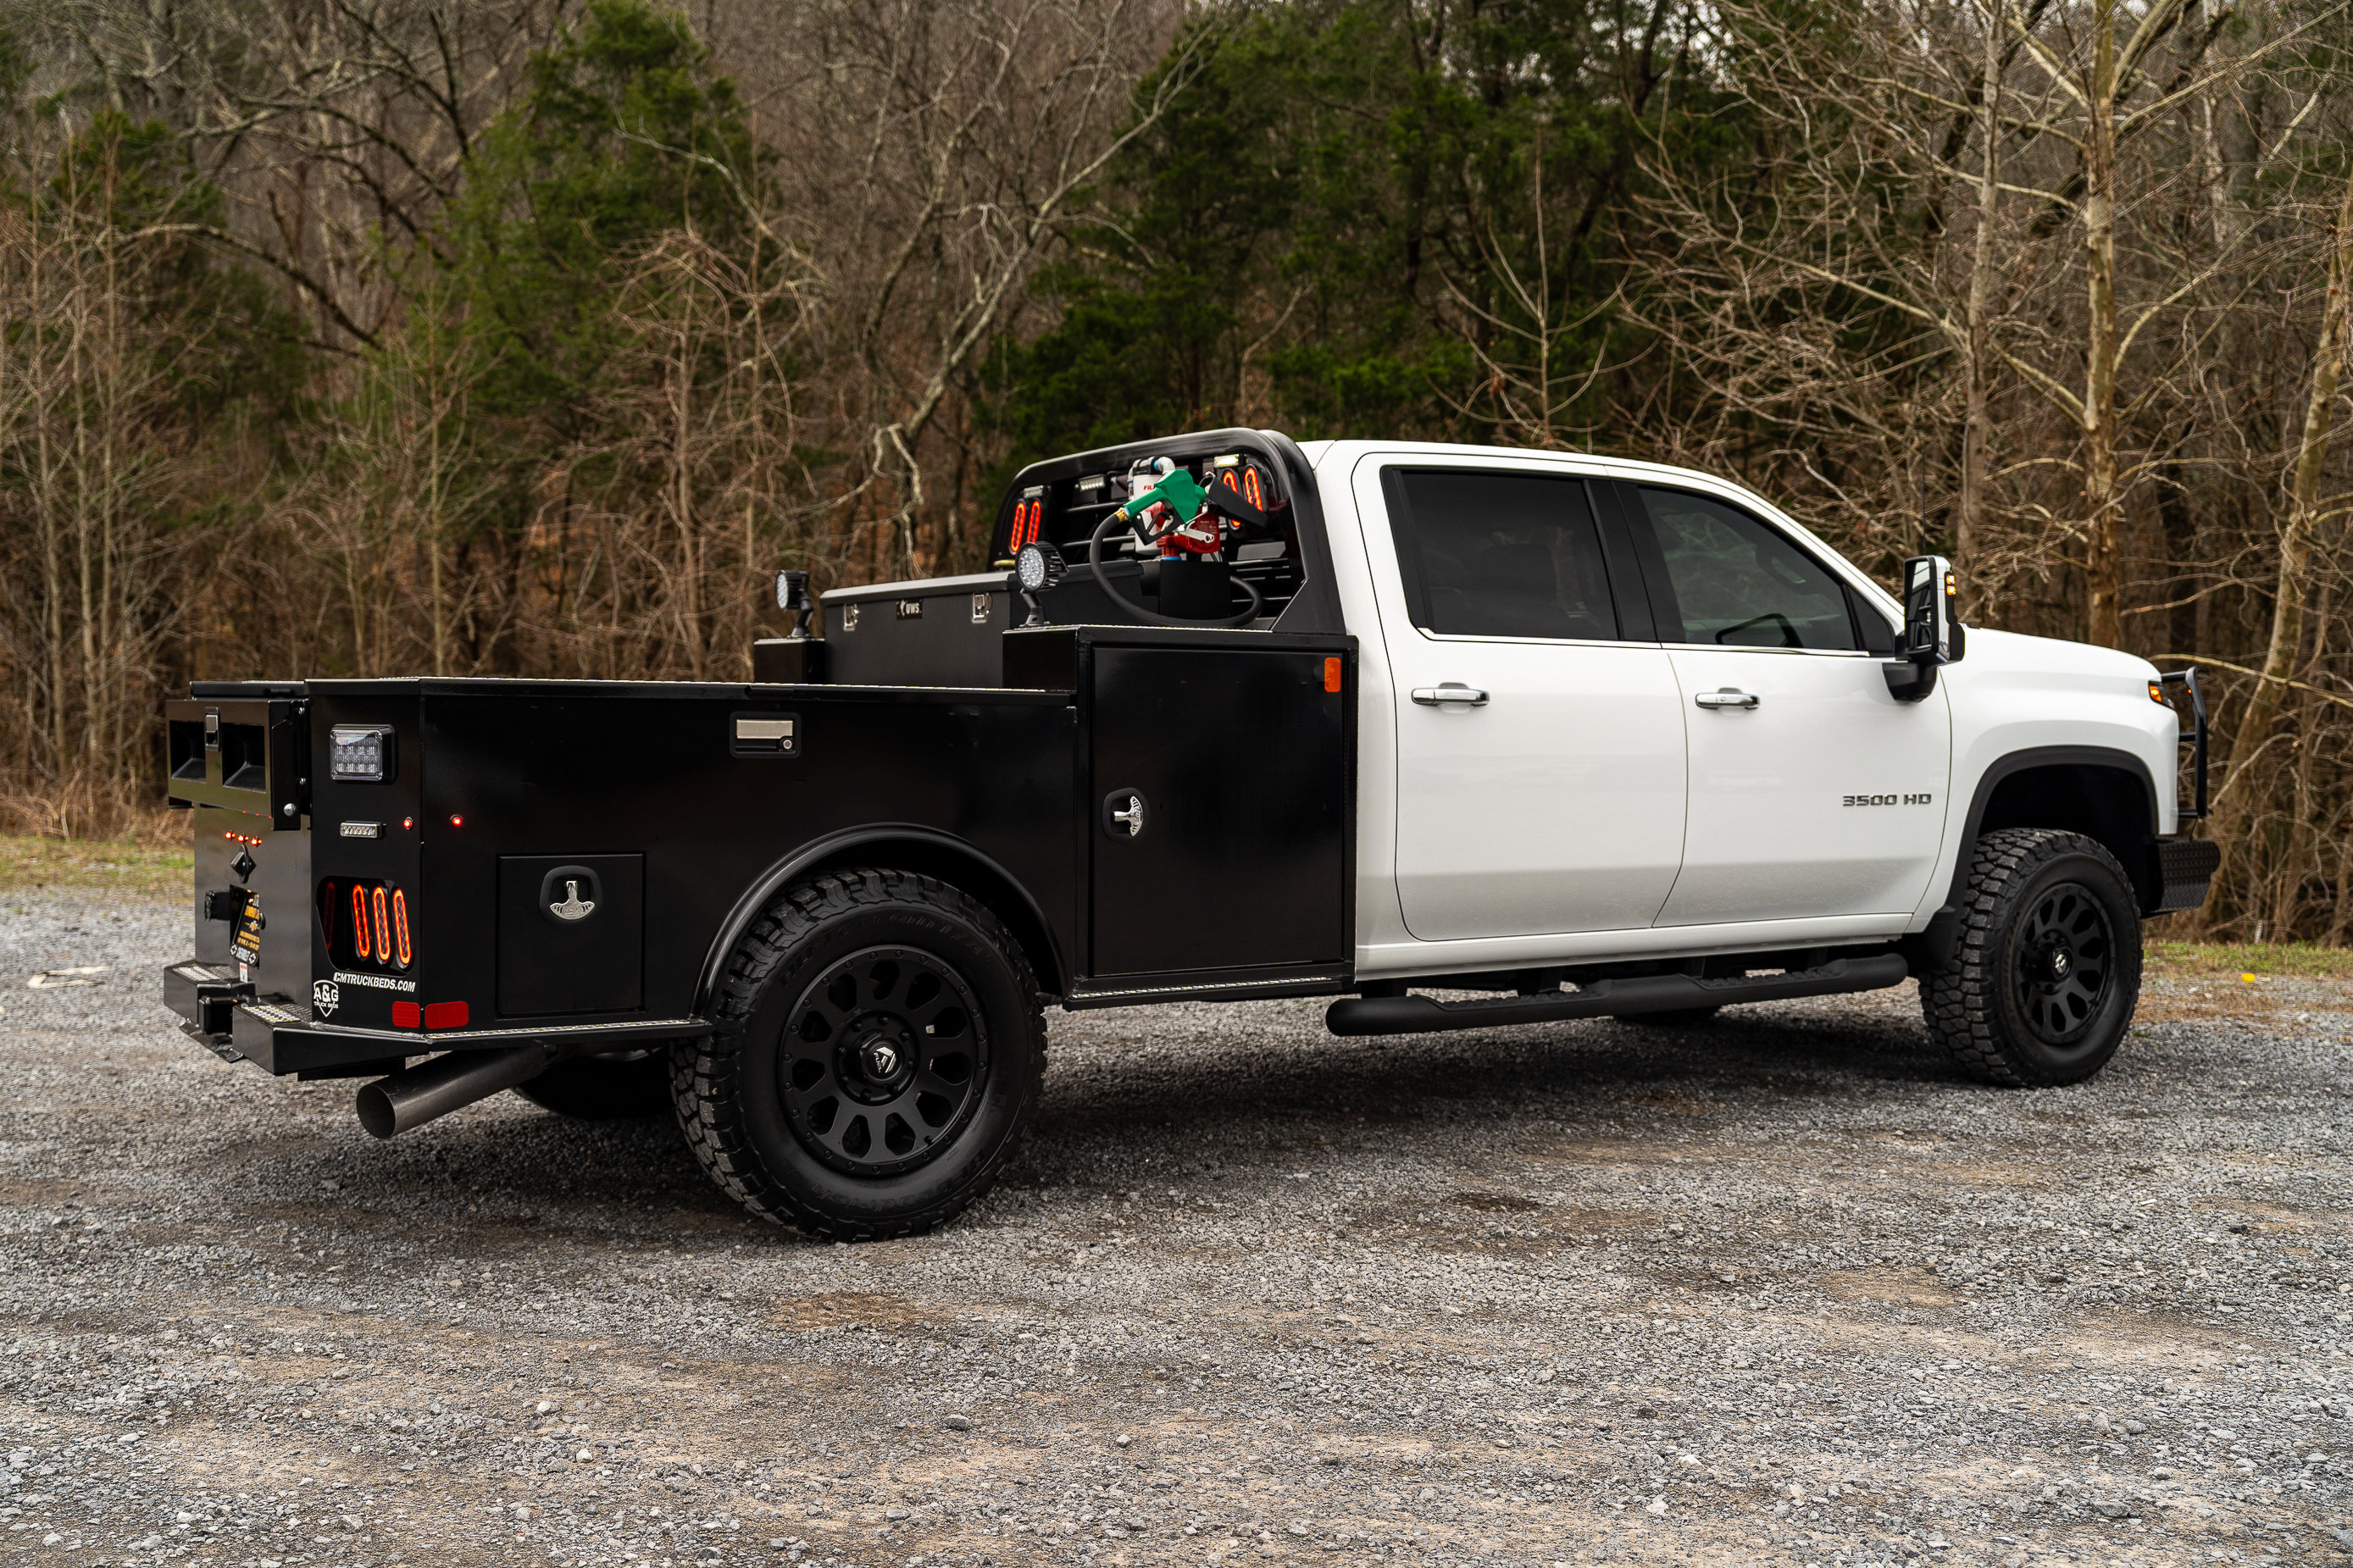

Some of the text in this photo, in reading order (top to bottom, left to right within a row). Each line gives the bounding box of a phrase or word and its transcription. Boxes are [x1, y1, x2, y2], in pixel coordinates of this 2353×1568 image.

[1842, 794, 1932, 806] 3500 HD
[333, 972, 415, 993] CMTRUCKBEDS.COM
[314, 984, 339, 1002] A&G
